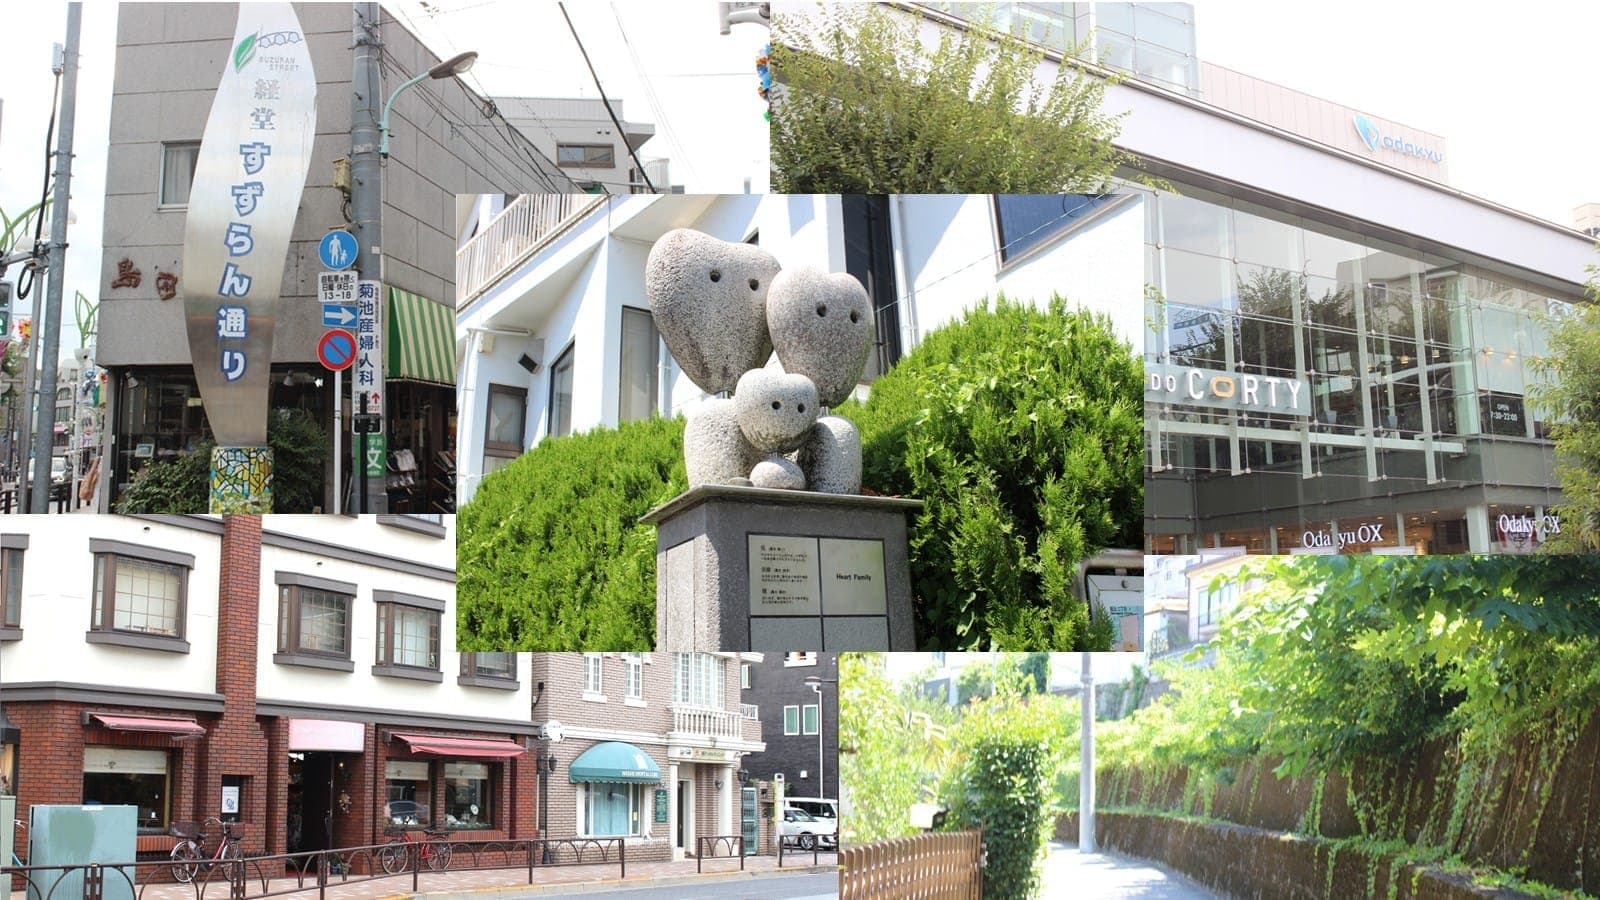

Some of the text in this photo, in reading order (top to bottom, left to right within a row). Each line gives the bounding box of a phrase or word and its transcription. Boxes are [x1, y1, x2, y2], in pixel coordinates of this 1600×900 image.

[260, 56, 296, 64] SUZURAN
[269, 63, 299, 71] STREET
[359, 283, 375, 386] 菊池産婦人科
[1188, 368, 1301, 409] CORTY
[1303, 524, 1384, 549] Odayu OX
[1500, 514, 1536, 538] Odaky
[836, 573, 872, 582] Heart Family
